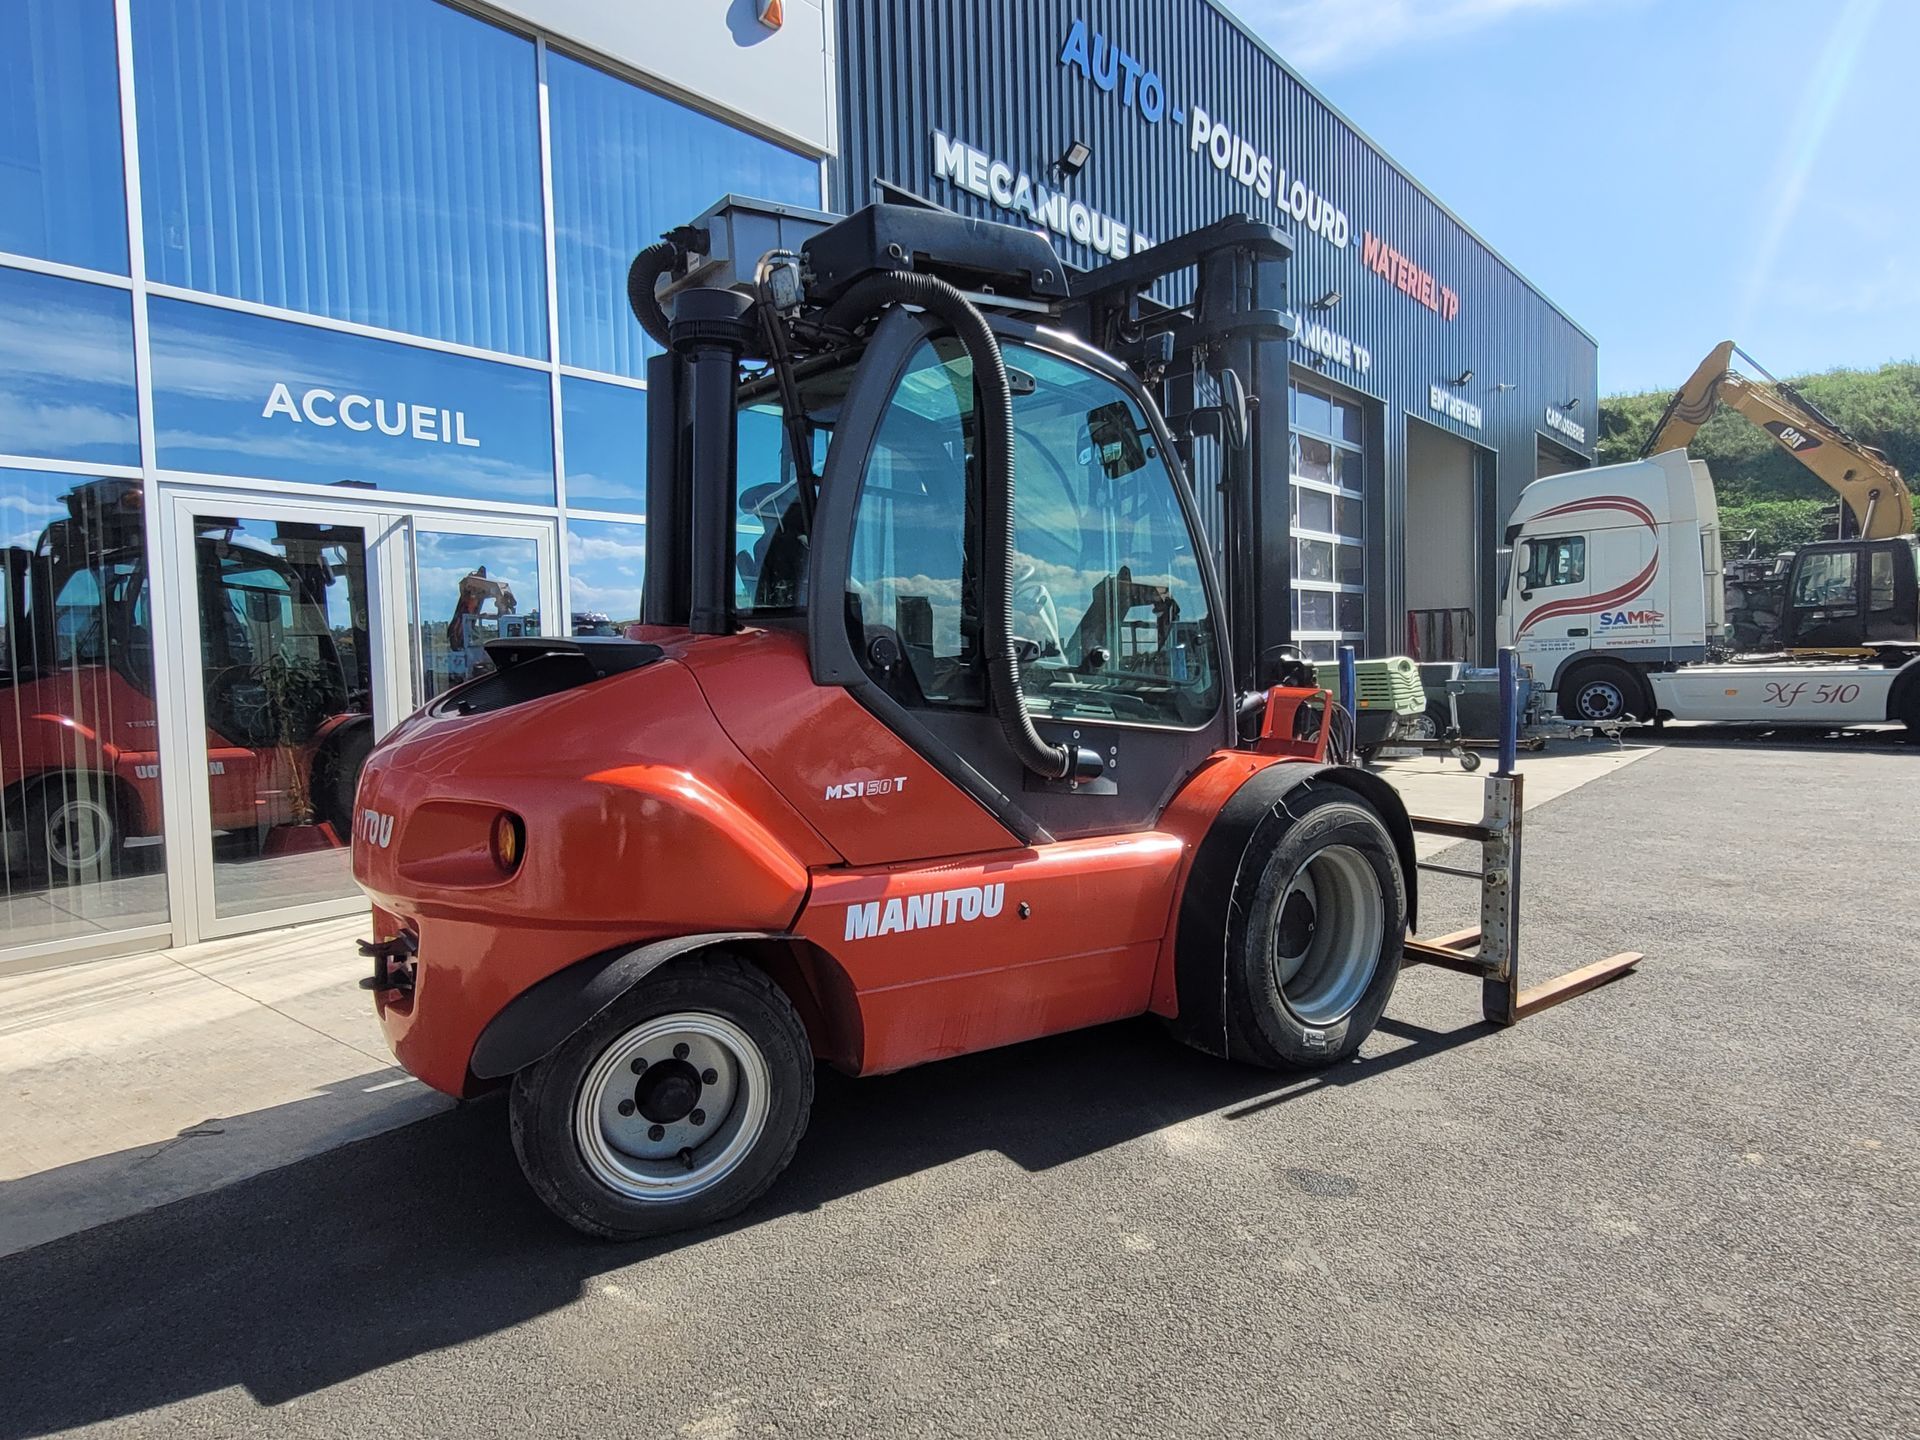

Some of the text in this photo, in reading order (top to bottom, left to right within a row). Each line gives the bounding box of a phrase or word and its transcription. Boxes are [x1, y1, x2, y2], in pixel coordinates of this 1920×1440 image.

[933, 130, 1128, 260] MECANIQUE
[1060, 19, 1164, 123] AUTO
[1190, 105, 1273, 199] POIDS
[1276, 168, 1348, 249] LOURD
[1363, 230, 1438, 313] MATERIEL
[1441, 284, 1460, 321] TP
[1287, 309, 1370, 375] ANIQUE TP
[261, 382, 481, 448] ACCUEIL
[1430, 385, 1482, 430] ENTRETIEN
[1779, 426, 1807, 449] CAT
[1600, 611, 1644, 625] SAM
[1811, 684, 1860, 704] 510
[844, 882, 1005, 942] MANITOU
